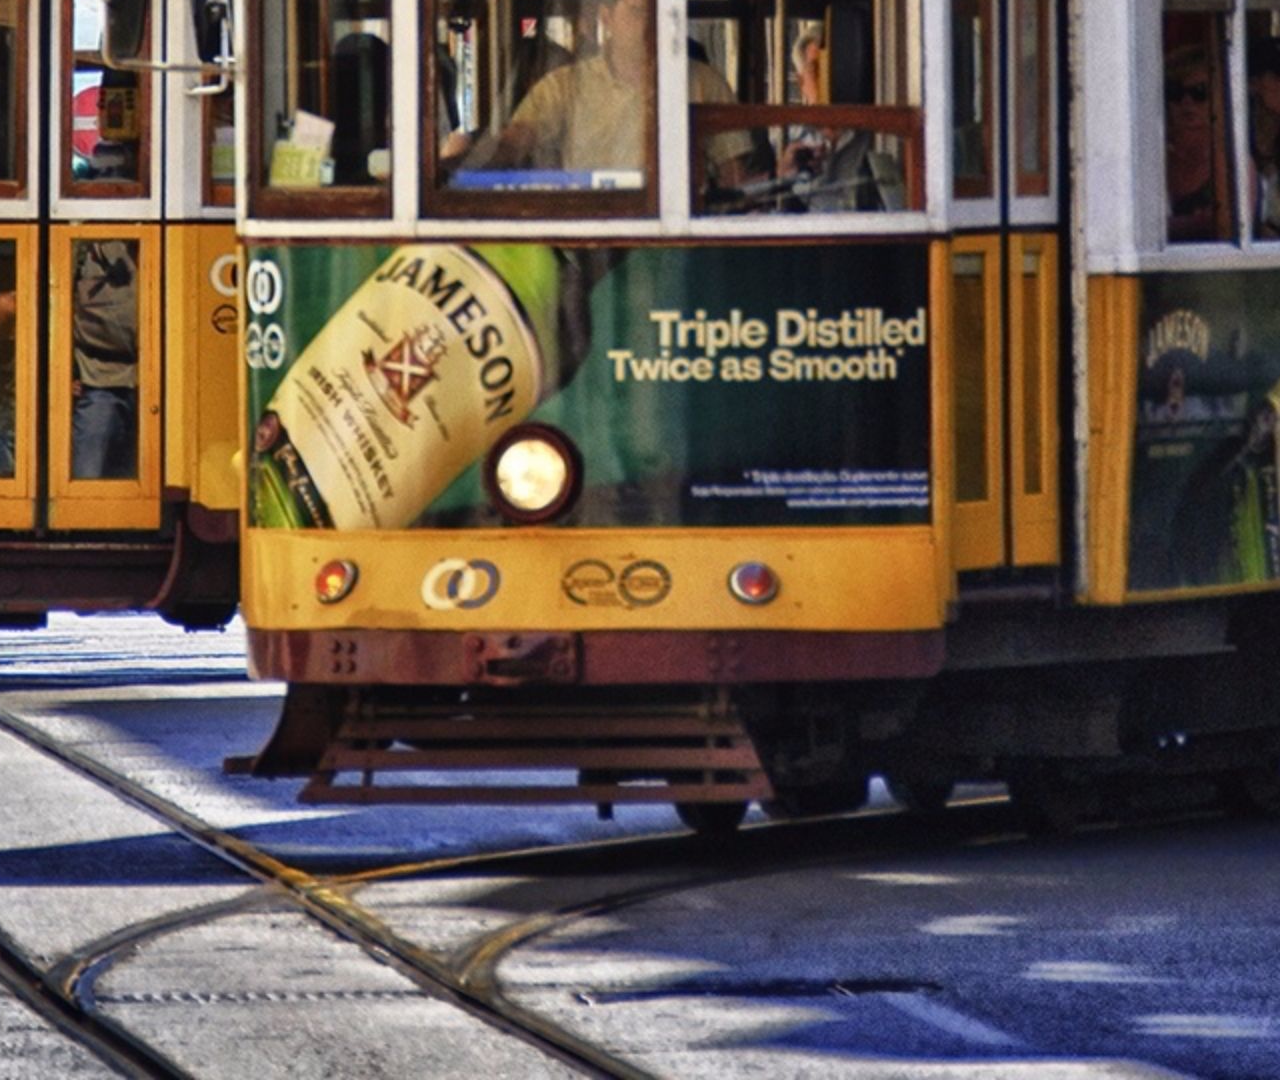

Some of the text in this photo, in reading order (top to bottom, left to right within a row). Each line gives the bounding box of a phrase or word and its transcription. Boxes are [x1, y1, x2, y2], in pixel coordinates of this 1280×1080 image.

[376, 255, 516, 424] JAMESON
[650, 308, 926, 357] Triple Distilled
[607, 349, 714, 382] Twice
[721, 356, 762, 381] as
